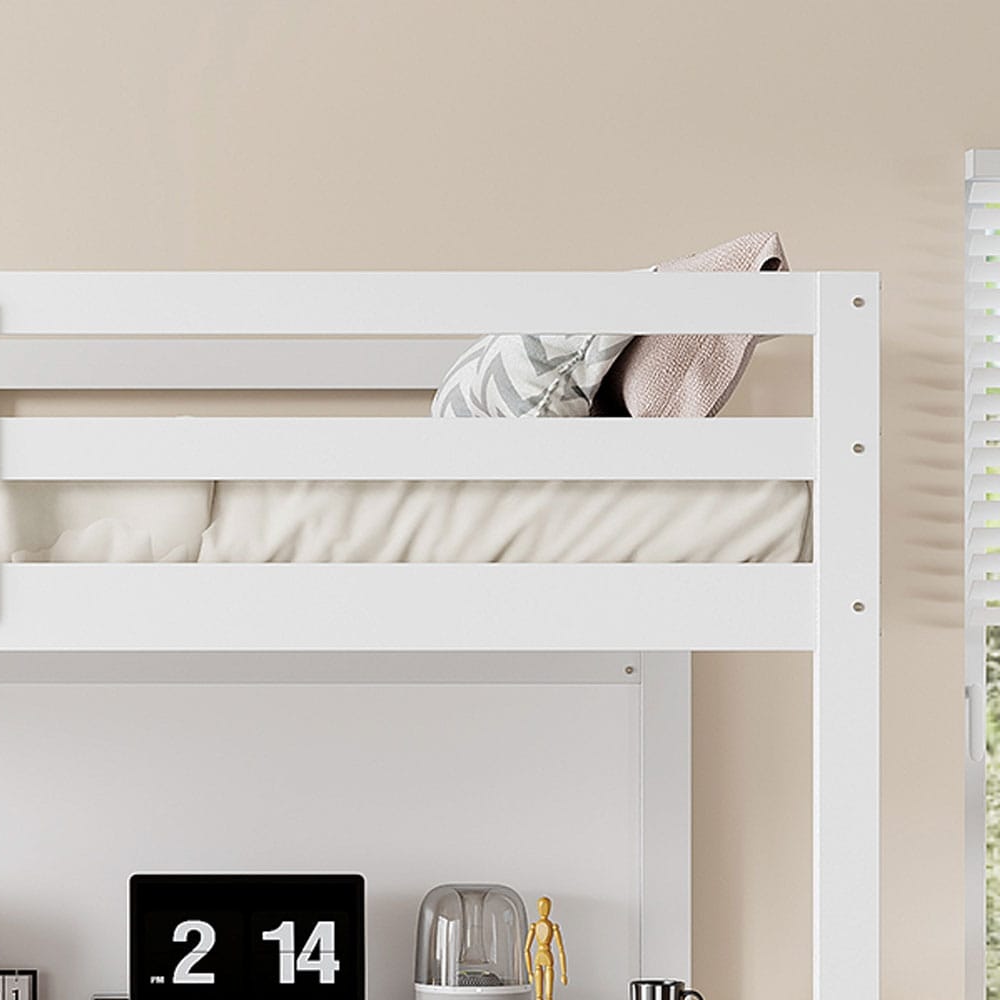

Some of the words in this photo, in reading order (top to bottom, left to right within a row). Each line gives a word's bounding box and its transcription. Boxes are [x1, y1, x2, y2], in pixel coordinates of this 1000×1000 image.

[150, 976, 165, 984] PM
[172, 920, 216, 984] 2
[262, 921, 340, 984] 14
